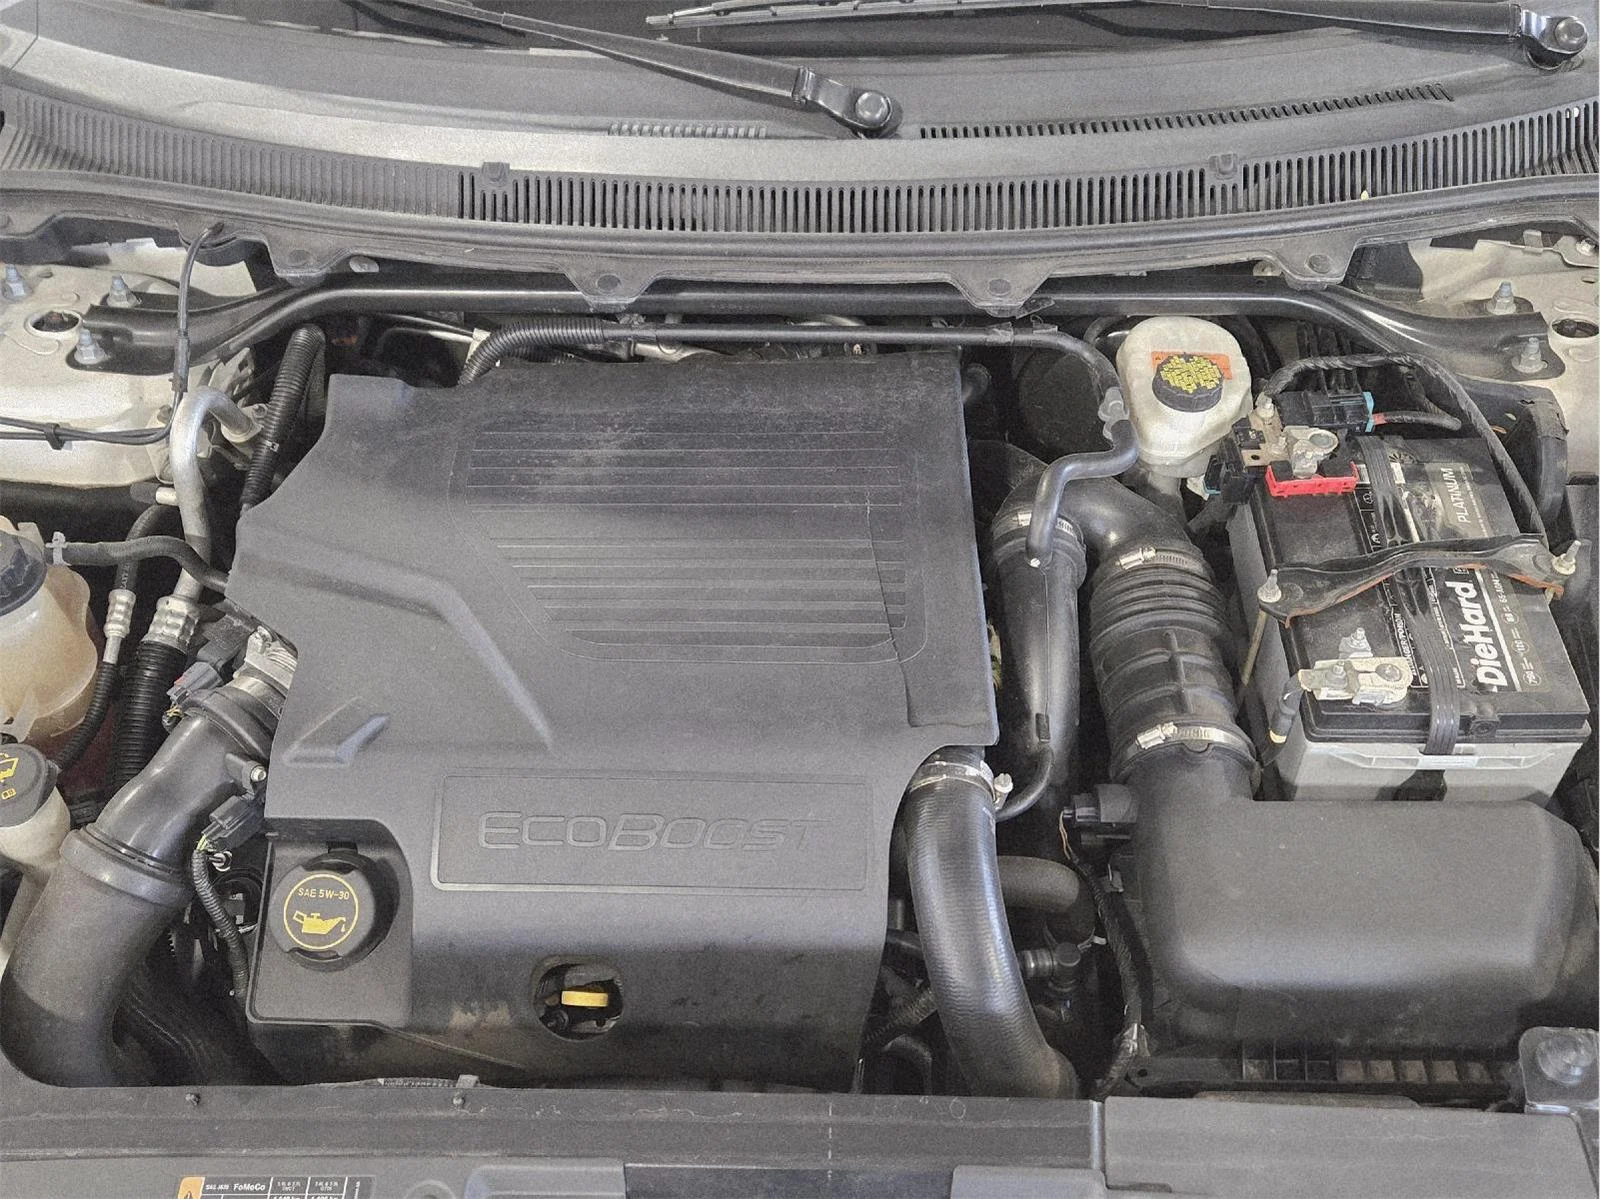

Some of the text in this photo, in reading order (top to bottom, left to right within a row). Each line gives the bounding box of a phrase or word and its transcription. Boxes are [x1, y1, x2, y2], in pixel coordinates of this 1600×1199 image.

[1440, 467, 1472, 523] PLATINUM
[1445, 581, 1508, 687] DieHard
[298, 887, 350, 900] SAE 5W-30
[233, 1183, 267, 1192] FoMoCo
